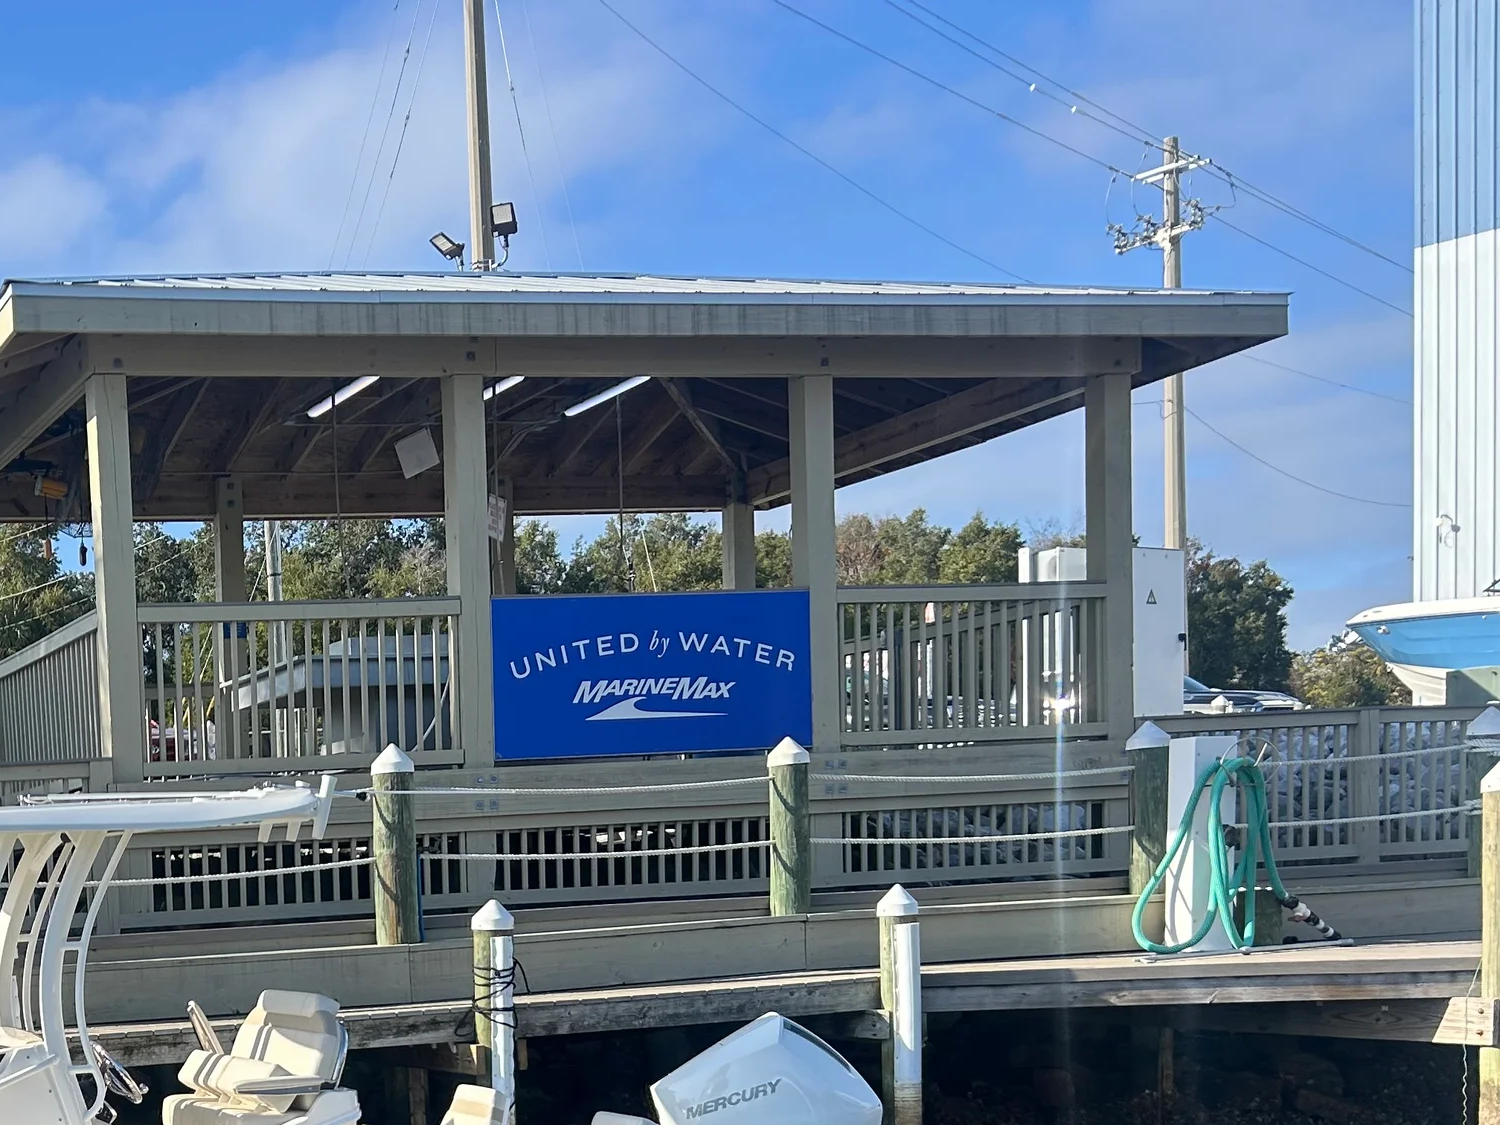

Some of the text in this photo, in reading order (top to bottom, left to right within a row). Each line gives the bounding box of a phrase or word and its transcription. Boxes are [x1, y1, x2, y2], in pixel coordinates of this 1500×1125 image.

[510, 630, 796, 679] UNITED by WATER
[686, 1078, 782, 1120] MERCURY
